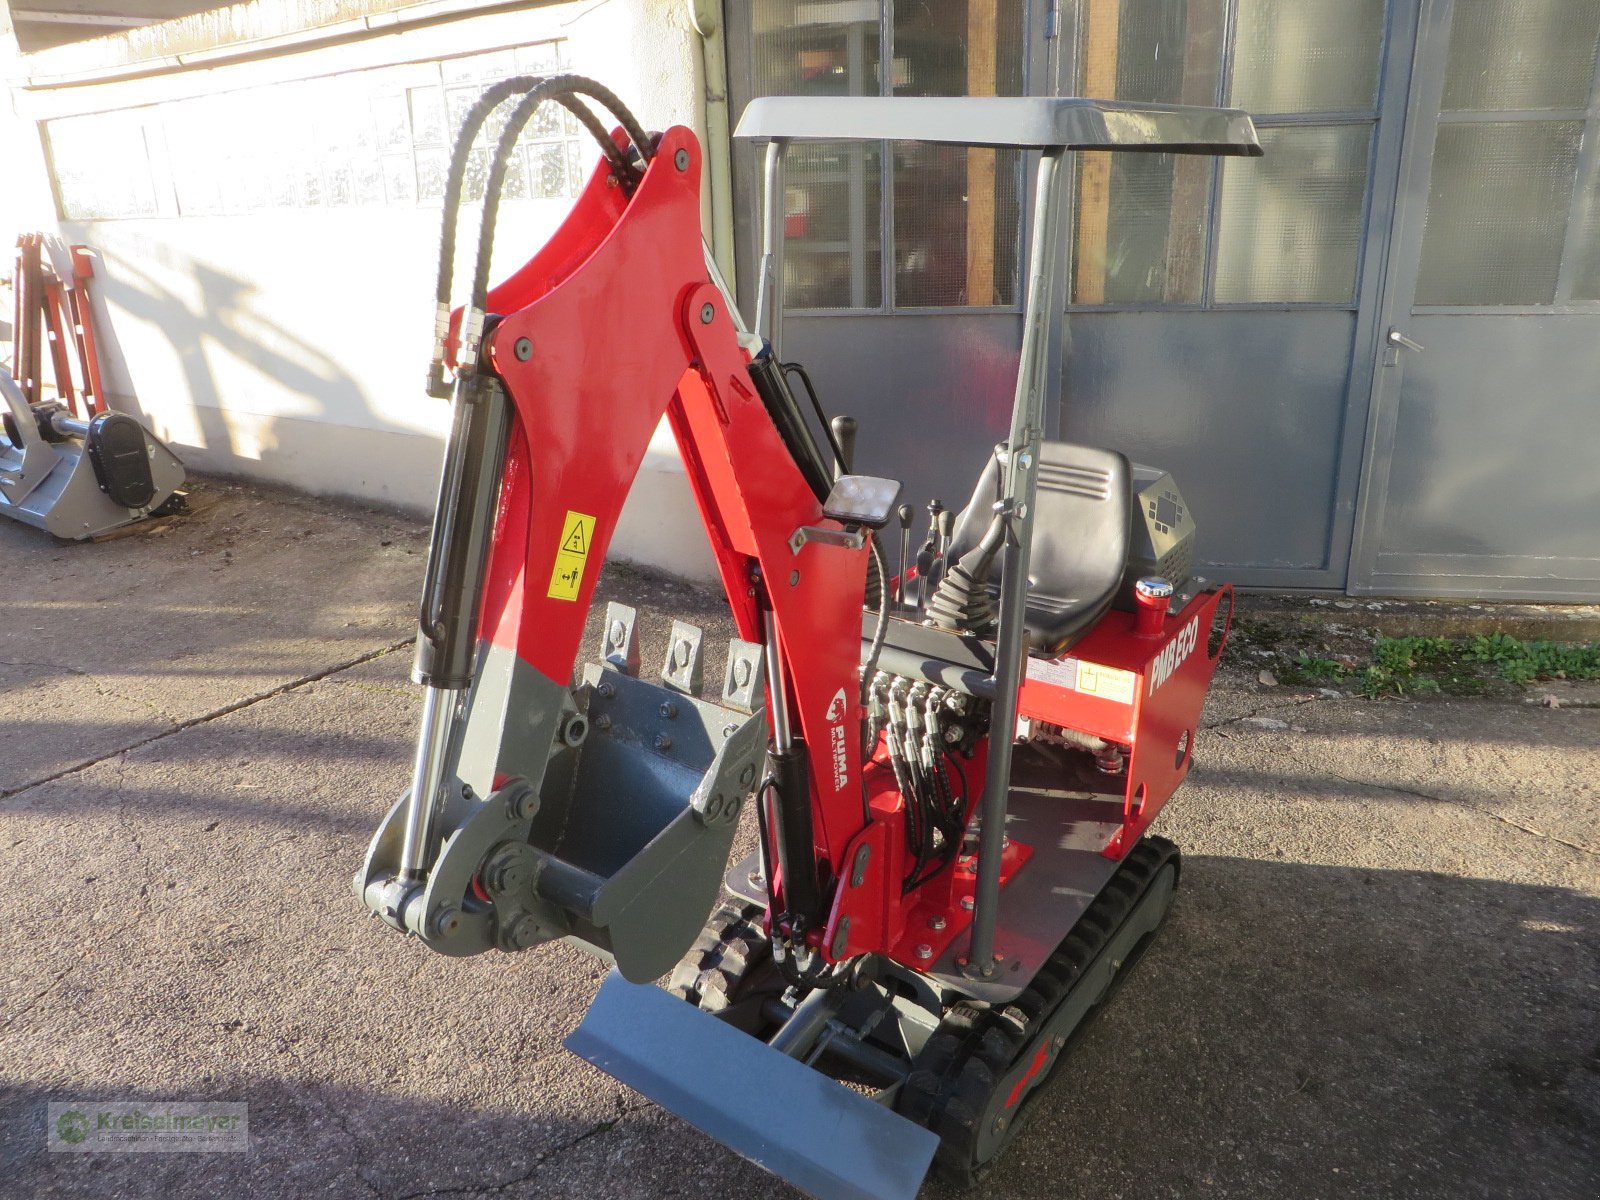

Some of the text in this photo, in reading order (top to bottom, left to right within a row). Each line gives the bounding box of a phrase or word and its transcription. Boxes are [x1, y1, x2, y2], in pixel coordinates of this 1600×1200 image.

[1174, 615, 1199, 670] ECO
[830, 727, 840, 792] MULTIPOWER
[835, 725, 848, 789] PUMA
